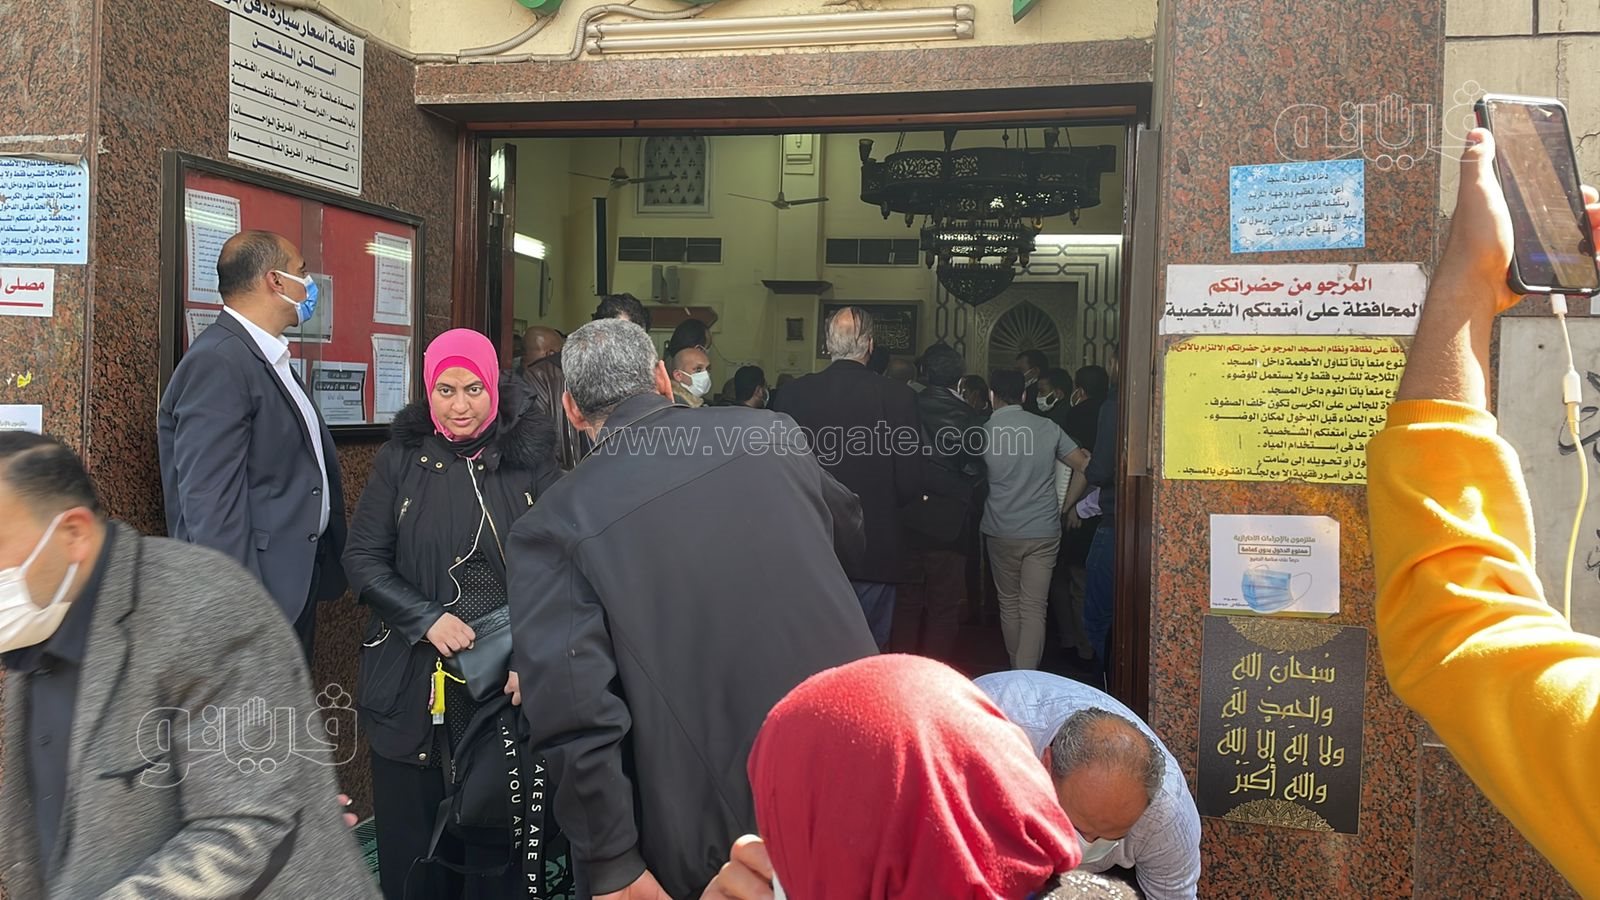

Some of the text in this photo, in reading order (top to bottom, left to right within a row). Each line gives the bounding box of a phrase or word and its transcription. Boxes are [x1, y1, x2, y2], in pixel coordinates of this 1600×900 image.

[270, 2, 300, 31] سيارة
[300, 20, 328, 42] أسعار
[329, 30, 356, 56] قائمة
[252, 31, 337, 77] أماكن الدفن
[1208, 276, 1372, 297] المرجو من حضراتكم
[1165, 300, 1423, 322] المحافظة على أمتعتكم الشخصية
[1227, 344, 1259, 353] حضراتكم
[1260, 345, 1271, 353] من
[1273, 345, 1297, 354] المرجو
[1298, 345, 1326, 354] المسجد
[1373, 346, 1389, 355] على
[1227, 358, 1258, 367] المسجد
[1262, 357, 1285, 367] داخل
[1324, 359, 1348, 369] تناول
[1227, 369, 1399, 383] الثلاجة للشرب فقط ولا يستعمل للوضوء
[1267, 386, 1301, 396] المسجد
[1301, 386, 1324, 396] داخل
[1325, 386, 1348, 397] النوم
[1245, 399, 1266, 407] خلف
[1267, 398, 1290, 408] تكون
[1325, 401, 1345, 411] على
[1345, 401, 1379, 411] للجالس
[1209, 411, 1386, 426] خلع الحذاء قبل الدخول لمكان الوضوء
[1263, 427, 1313, 437] الشخصية
[1348, 429, 1368, 440] على
[1306, 456, 1342, 468] تحويله
[1183, 466, 1216, 476] بالمسجد
[1293, 469, 1317, 479] فقهية
[508, 767, 522, 804] YOU
[531, 759, 546, 812] AKES
[527, 824, 541, 861] ARE
